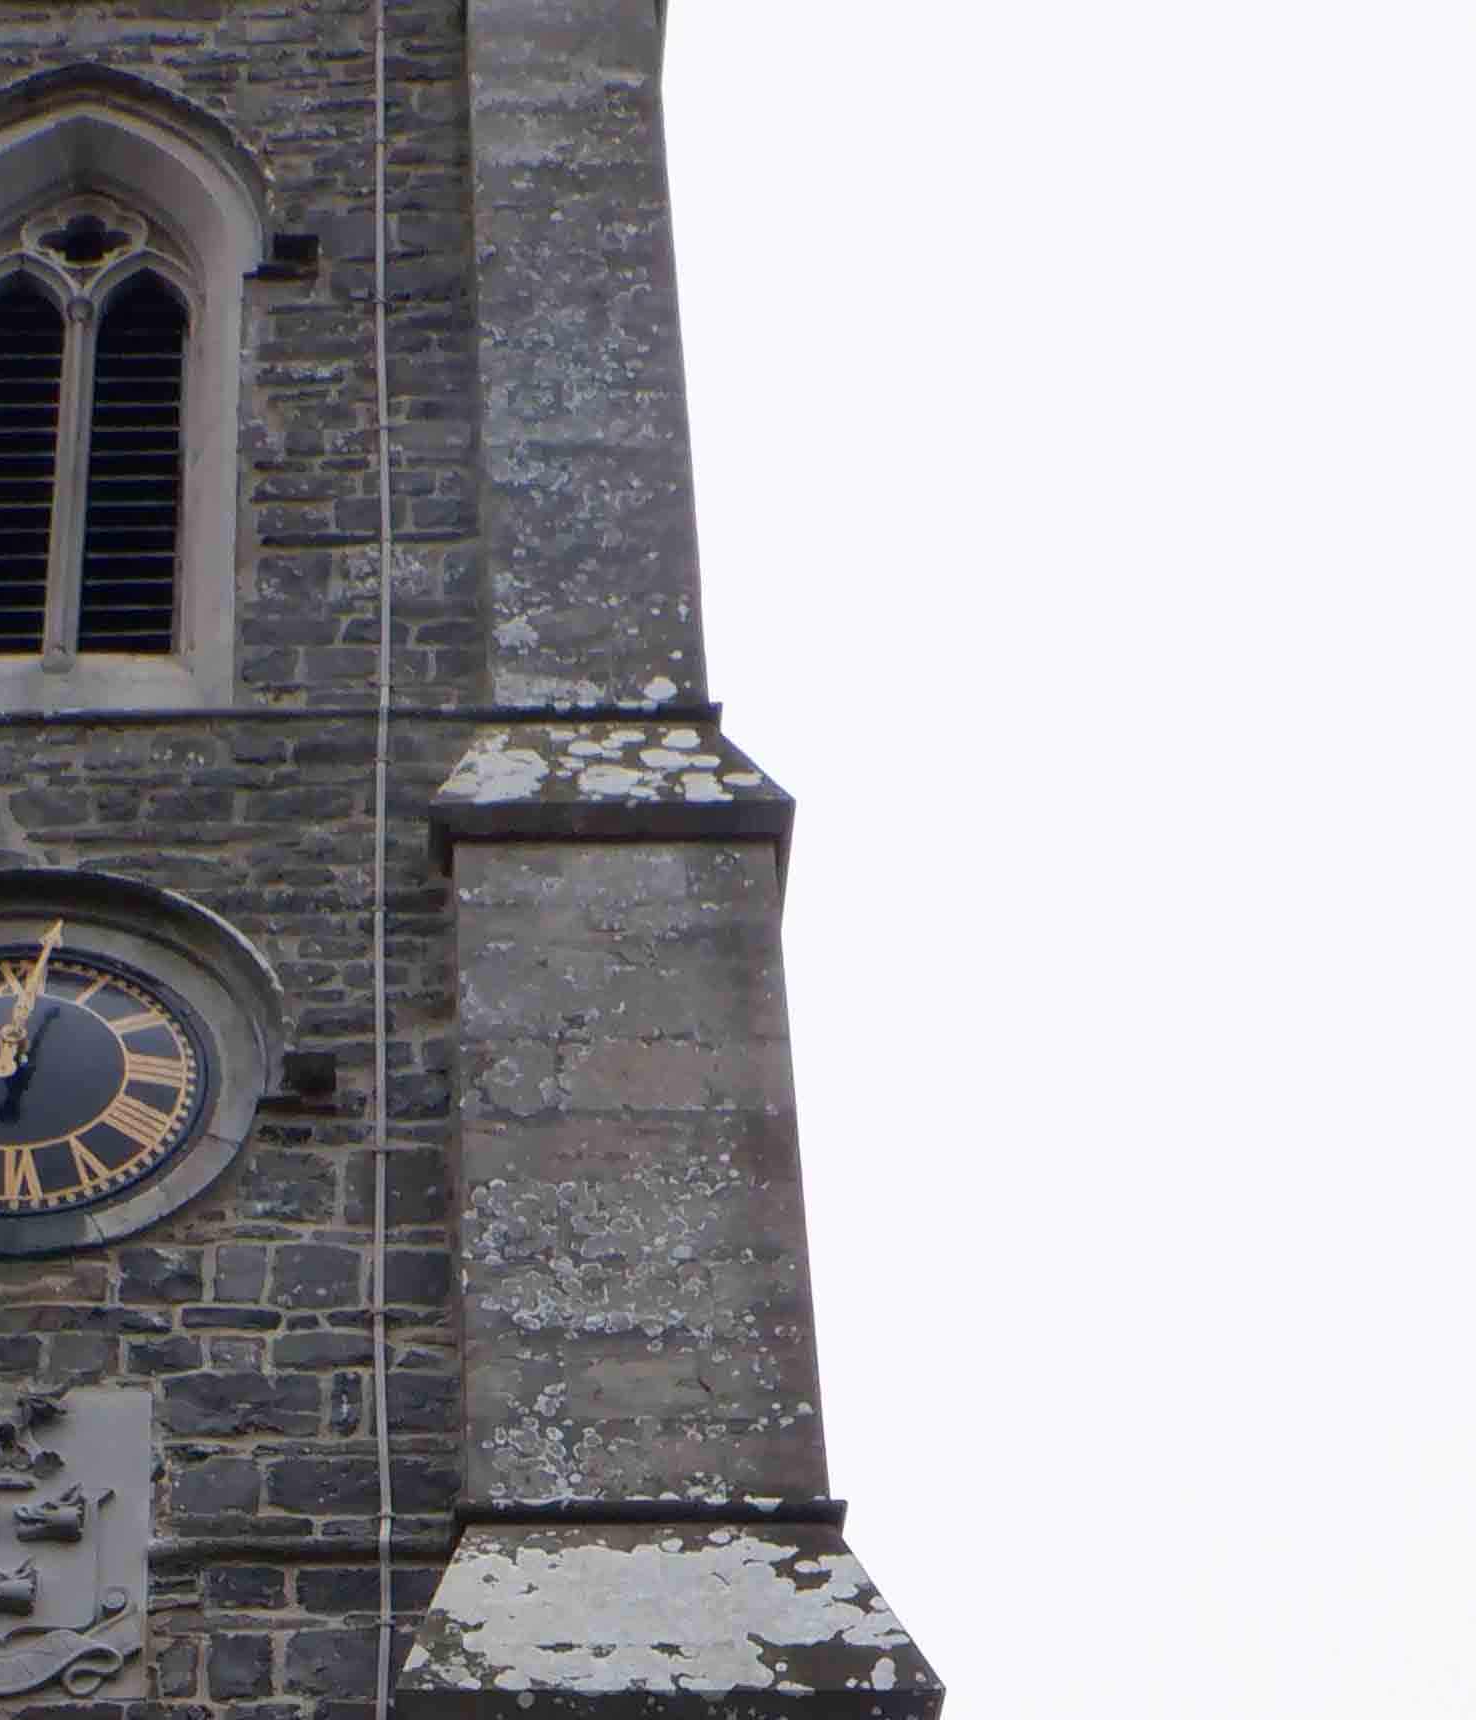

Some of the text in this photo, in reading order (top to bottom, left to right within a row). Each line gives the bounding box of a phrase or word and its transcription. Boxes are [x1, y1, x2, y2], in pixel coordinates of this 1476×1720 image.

[76, 976, 109, 1005] I
[110, 1012, 167, 1033] II
[127, 1054, 185, 1087] III
[101, 1095, 175, 1150] IIII
[4, 1147, 43, 1199] VI
[69, 1136, 111, 1186] V
